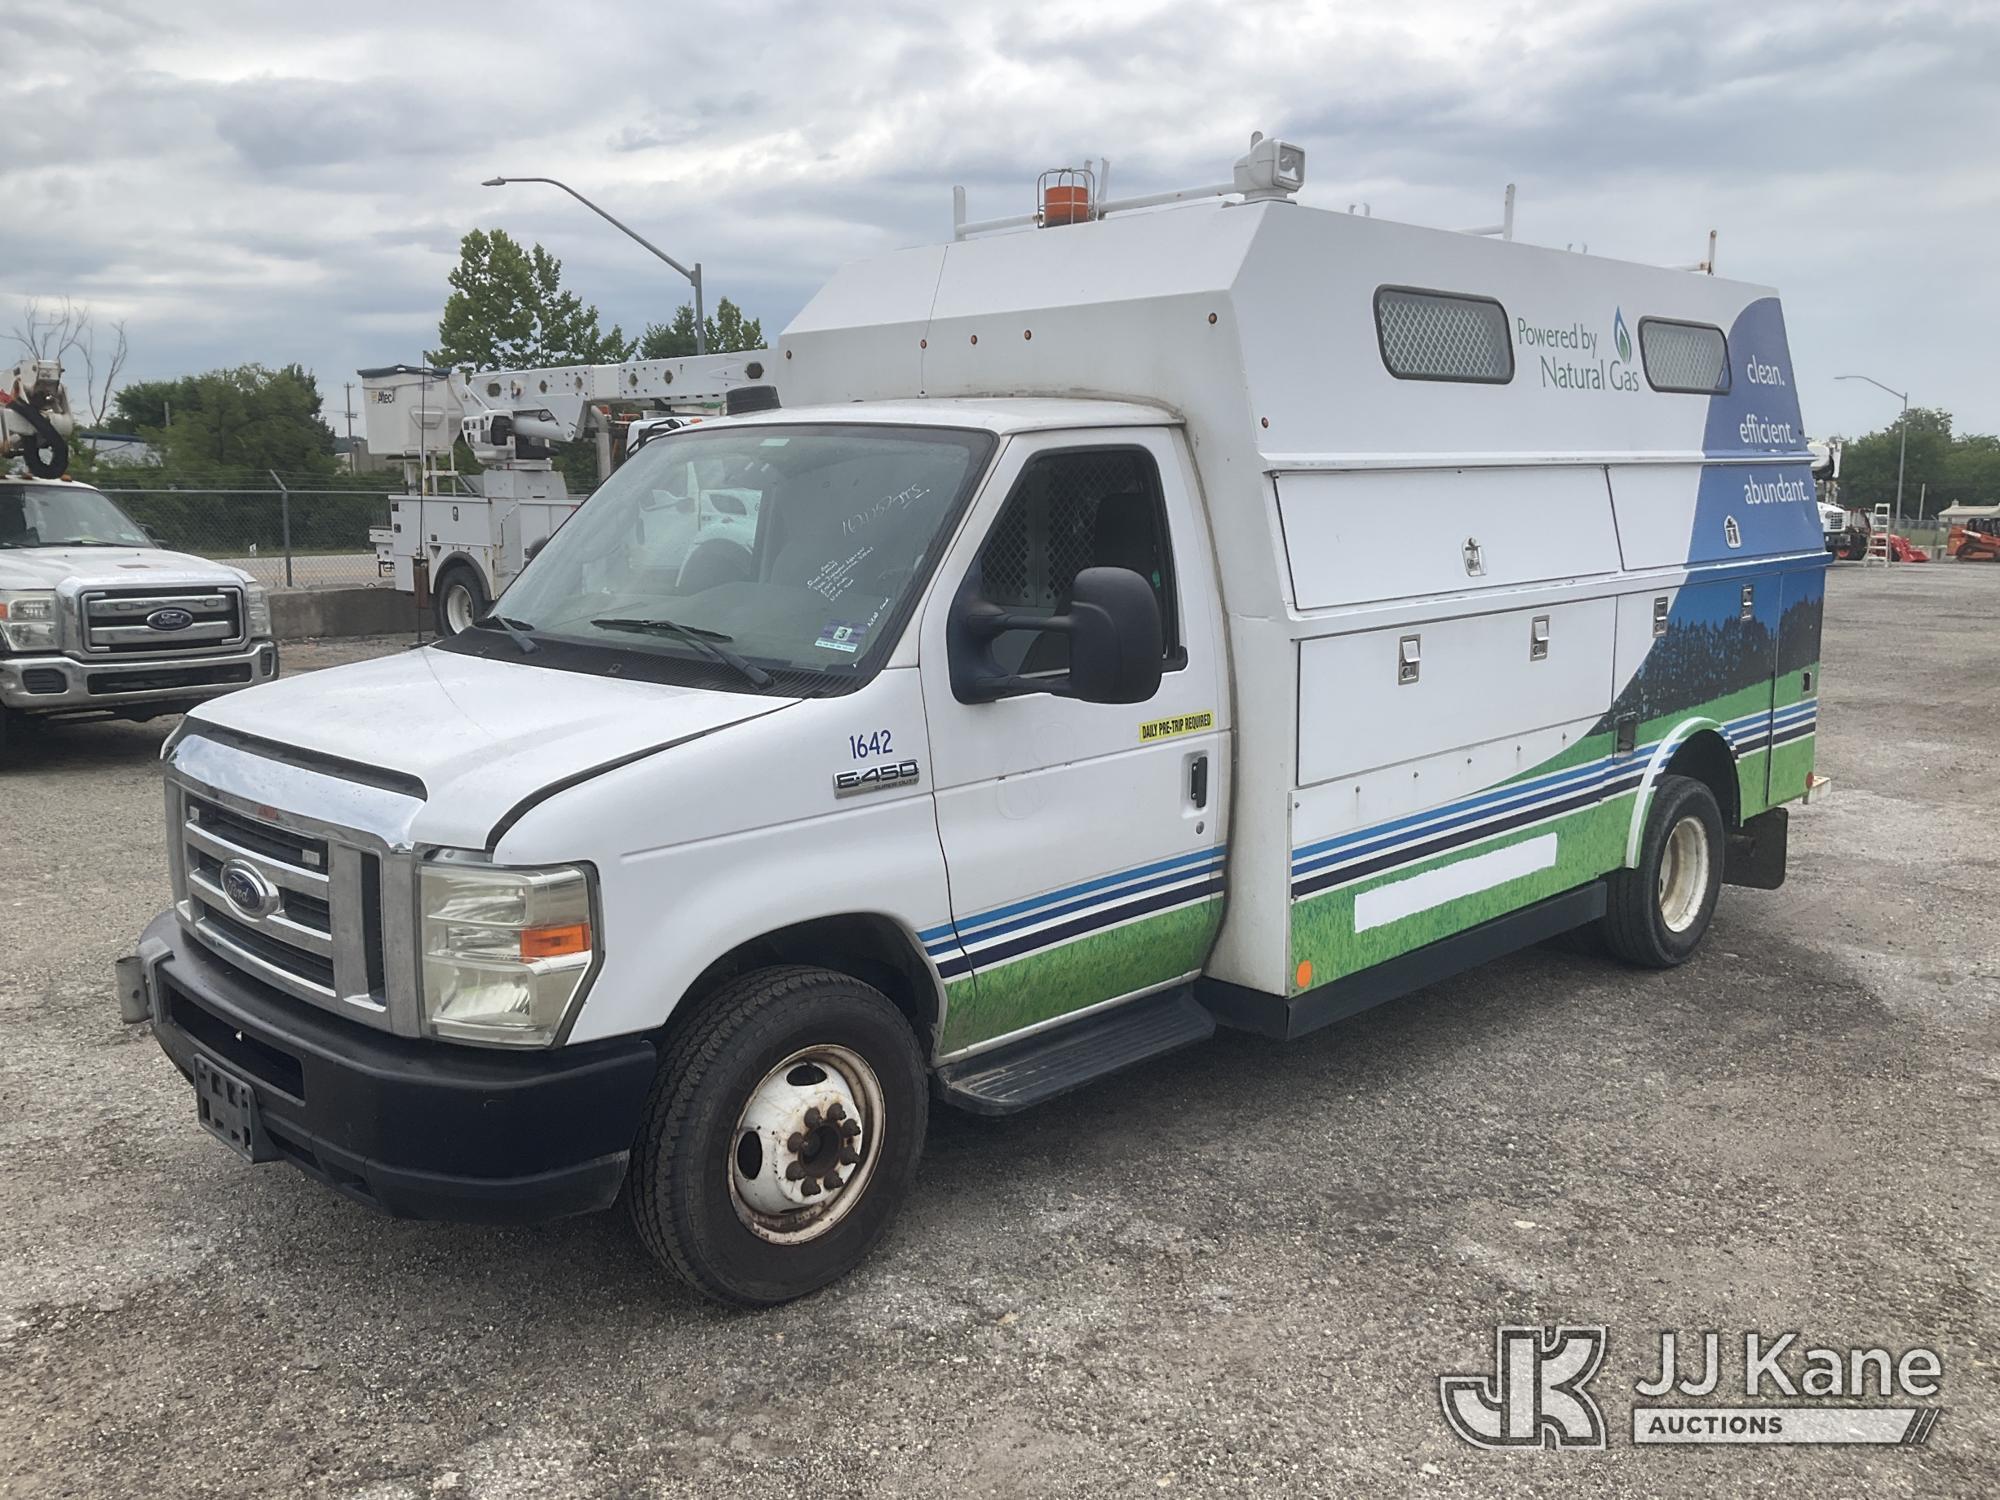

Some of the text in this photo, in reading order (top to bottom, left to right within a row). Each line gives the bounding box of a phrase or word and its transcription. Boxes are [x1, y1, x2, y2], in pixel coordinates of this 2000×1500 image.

[1517, 317, 1598, 359] Powered by
[1540, 355, 1640, 392] Natural Gas
[1747, 354, 1785, 386] clean.
[1739, 413, 1797, 444] efficient.
[1744, 473, 1809, 504] abundant.
[1142, 713, 1211, 739] DAILY PRE-TRIP REQUIRED
[849, 729, 893, 759] 1642
[836, 762, 919, 789] E-450
